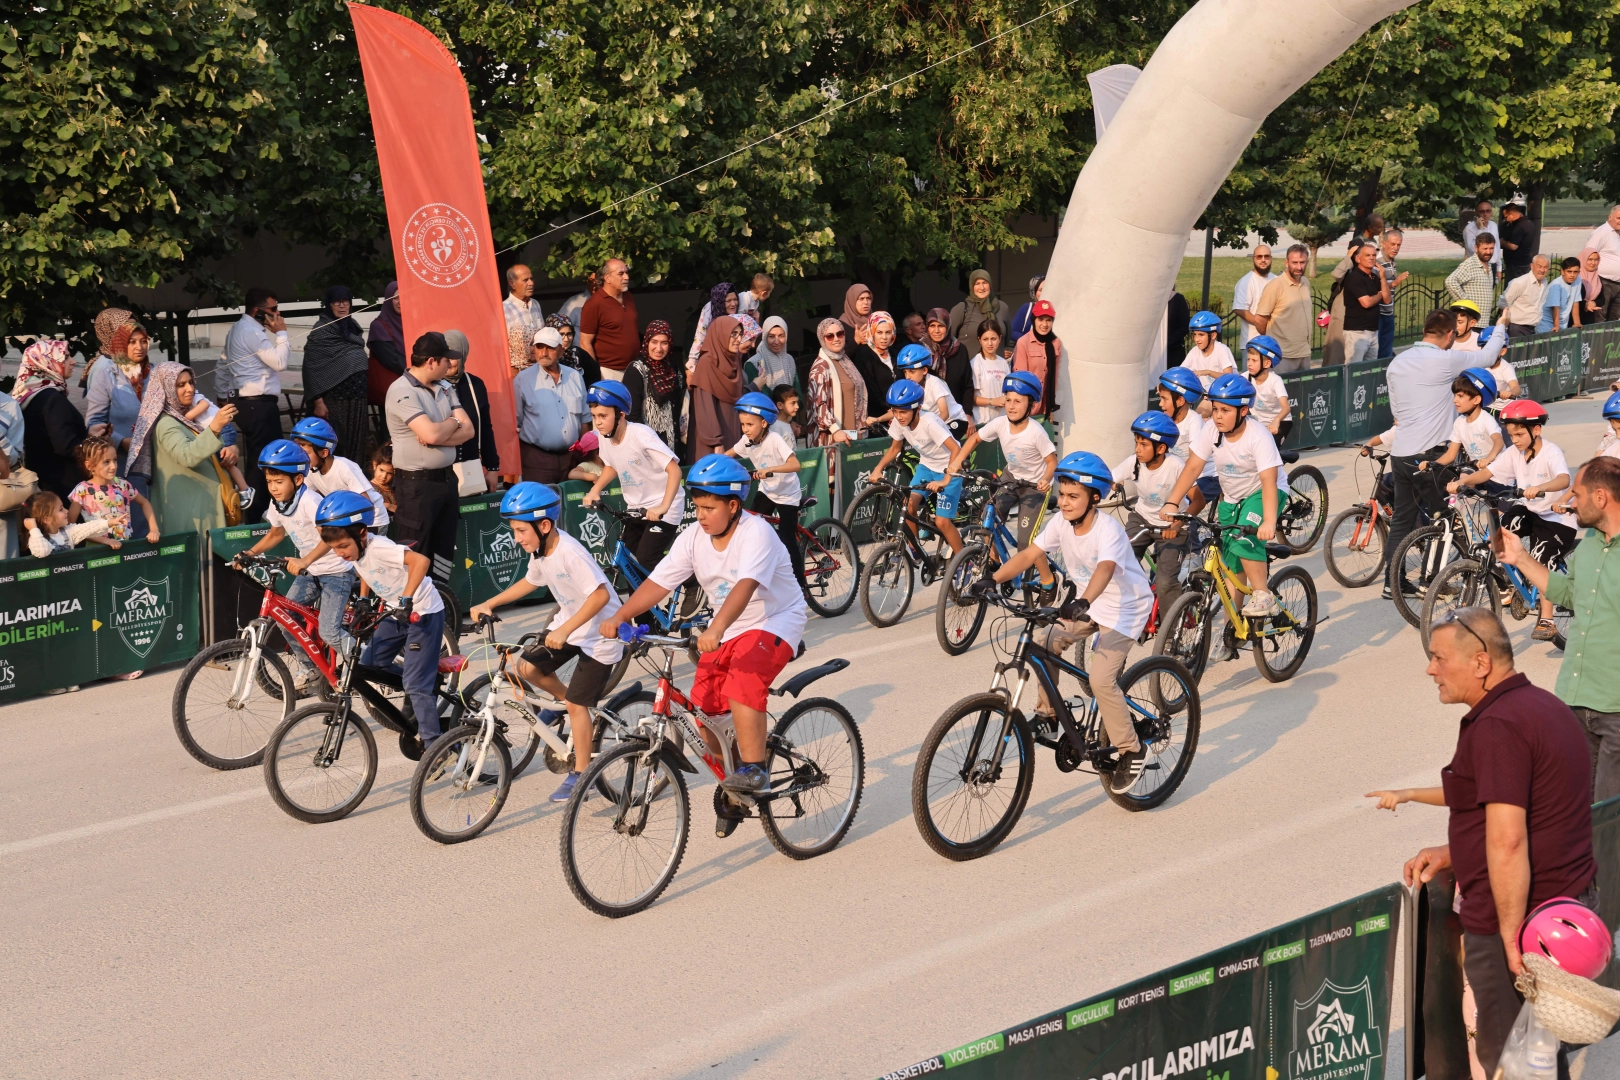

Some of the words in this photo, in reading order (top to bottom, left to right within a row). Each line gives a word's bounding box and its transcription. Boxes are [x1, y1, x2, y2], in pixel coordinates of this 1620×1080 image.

[1309, 407, 1328, 416] MERAM
[123, 550, 158, 561] TAEKWONDO
[484, 548, 521, 565] MERAM
[115, 604, 166, 626] MERAM
[134, 636, 151, 646] 1996
[679, 714, 706, 750] Bianchi
[948, 1039, 999, 1063] VOLEYBOL
[1008, 1026, 1035, 1046] MASA
[1035, 1018, 1063, 1037] TENİSİ
[1071, 1005, 1110, 1026] OKÇULUK
[1117, 995, 1140, 1011] KORT
[1140, 985, 1165, 1003] TENİSİ
[1174, 971, 1211, 992] SATRANÇ
[1283, 943, 1302, 958] BOKS
[1309, 926, 1352, 948] TAEKWONDO
[1360, 915, 1387, 933] YÜZME
[1295, 1032, 1372, 1076] MERAM
